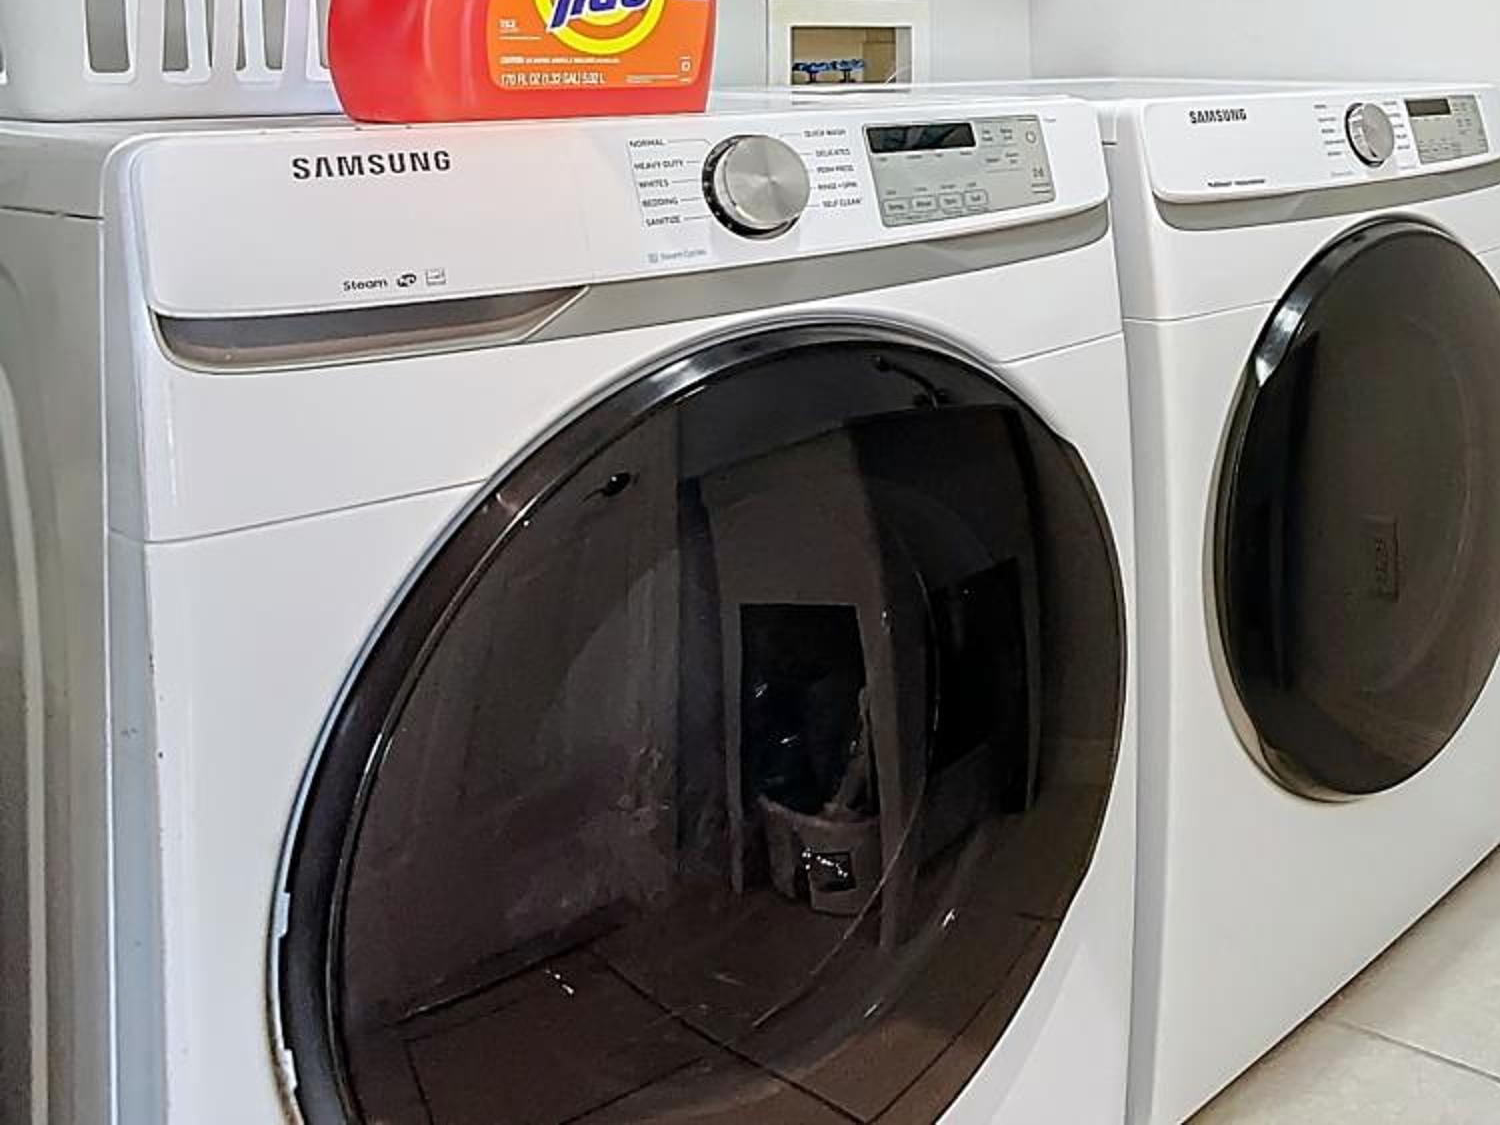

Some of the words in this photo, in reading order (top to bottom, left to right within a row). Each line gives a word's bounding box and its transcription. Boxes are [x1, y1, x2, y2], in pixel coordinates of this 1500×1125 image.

[1189, 108, 1247, 124] SAMSUNG
[629, 138, 666, 148] NORMAL
[291, 150, 451, 180] SAMSUNG
[343, 278, 388, 292] Steam
